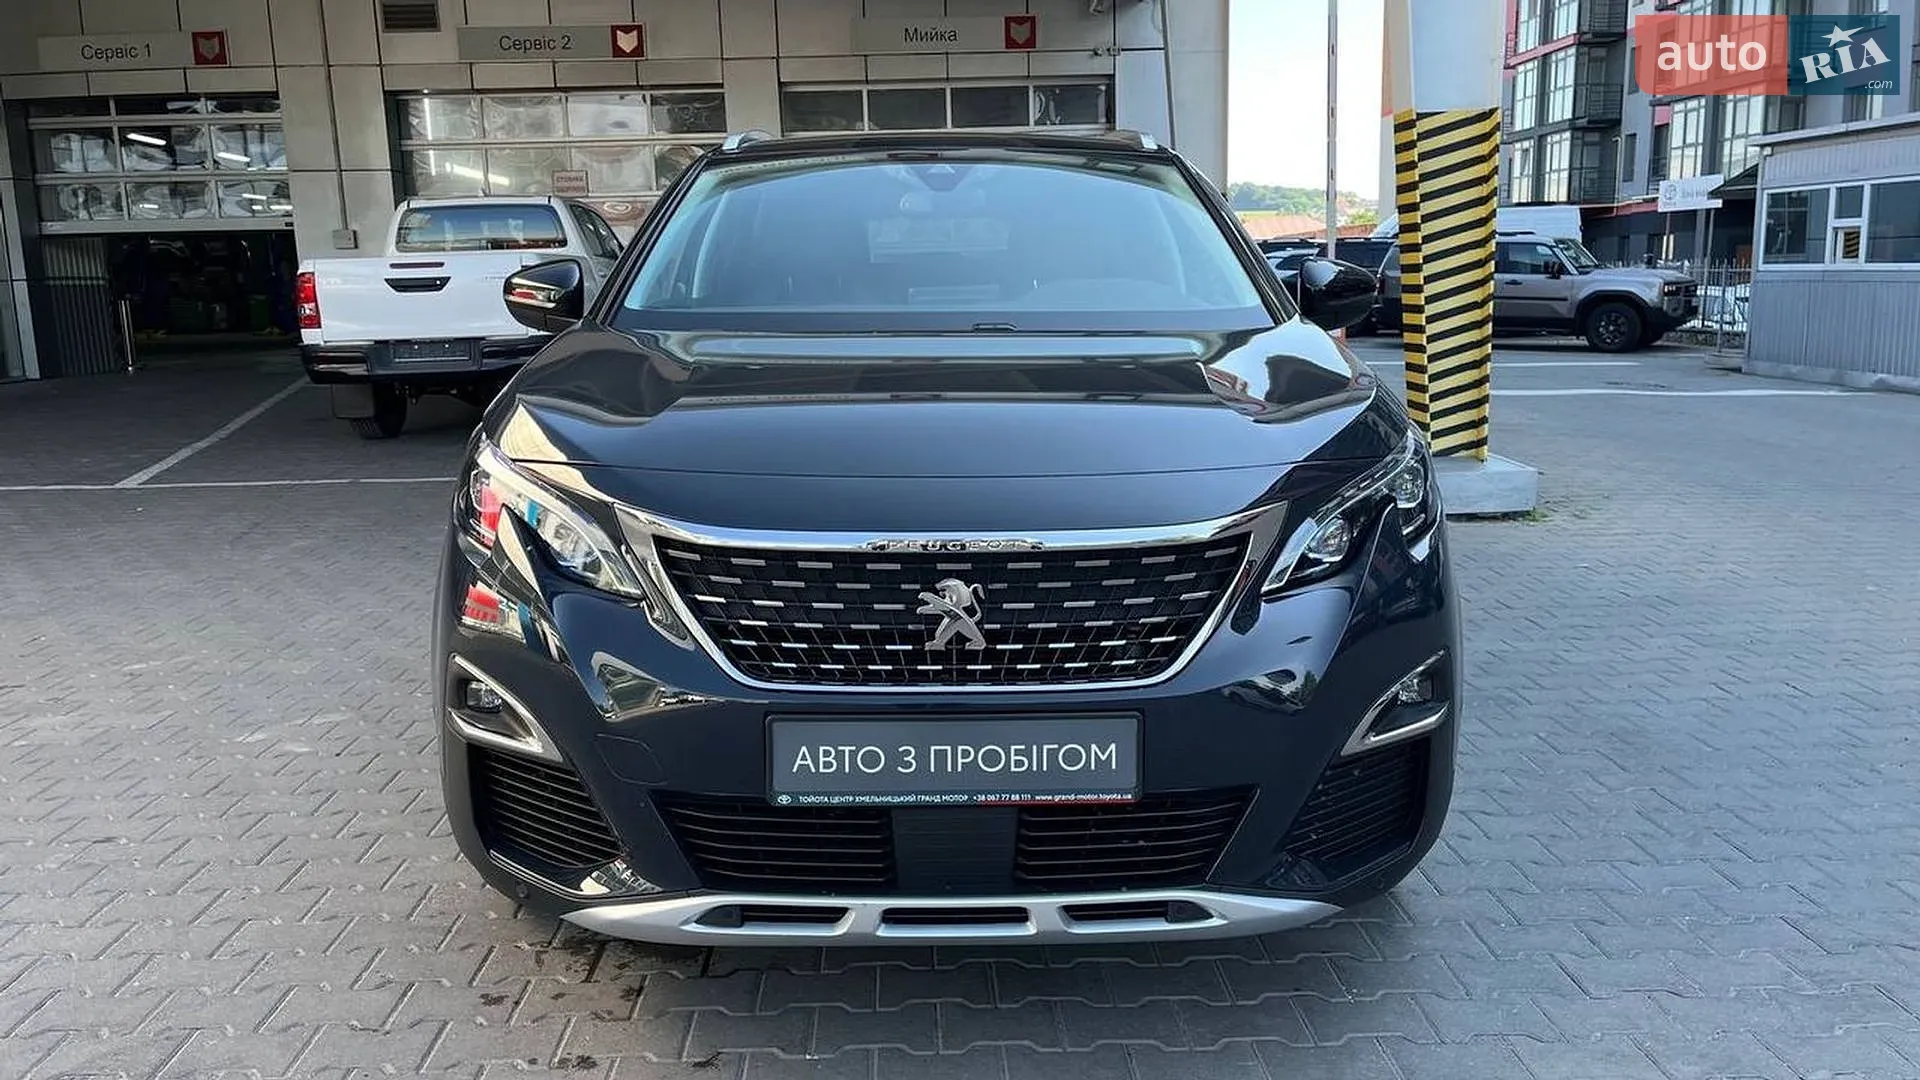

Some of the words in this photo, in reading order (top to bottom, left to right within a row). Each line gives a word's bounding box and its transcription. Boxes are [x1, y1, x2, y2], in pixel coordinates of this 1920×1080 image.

[904, 27, 959, 42] Мийка
[81, 43, 139, 62] Сервіс
[143, 43, 152, 57] 1
[499, 35, 557, 53] Сервіс
[561, 35, 572, 50] 2
[792, 745, 886, 774] АВТО
[930, 743, 1118, 773] ПРОБІГОМ
[799, 794, 829, 804] ТОЙОТА
[830, 795, 854, 804] ЦЕНТР
[917, 794, 941, 803] ГРАНД
[942, 793, 968, 802] МОТОР
